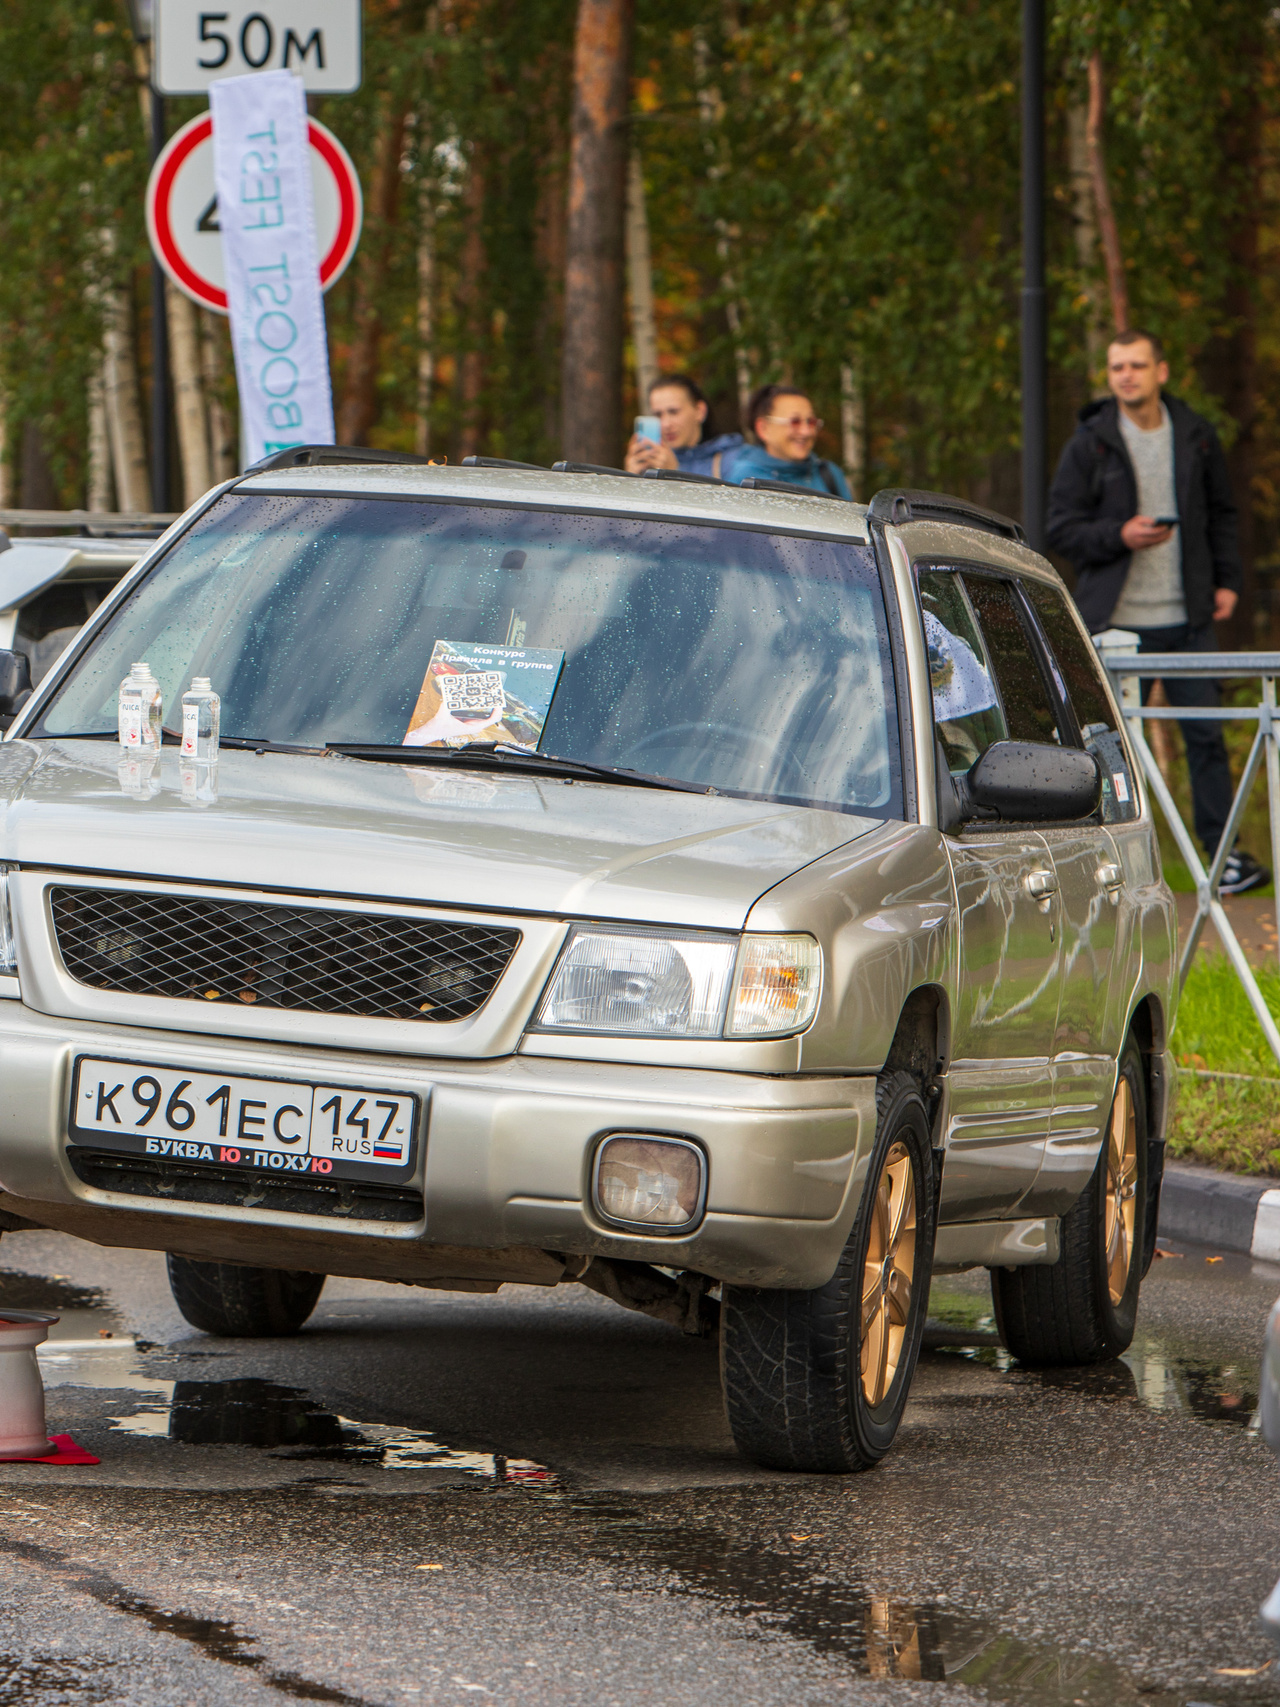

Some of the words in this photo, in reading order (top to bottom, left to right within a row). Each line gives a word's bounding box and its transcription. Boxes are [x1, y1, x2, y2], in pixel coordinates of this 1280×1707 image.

[473, 646, 526, 658] Конкурс
[440, 653, 492, 665] Правила
[511, 660, 554, 671] группе
[320, 1095, 400, 1141] 147
[145, 1138, 215, 1161] БУКВА
[332, 1137, 371, 1155] RUS
